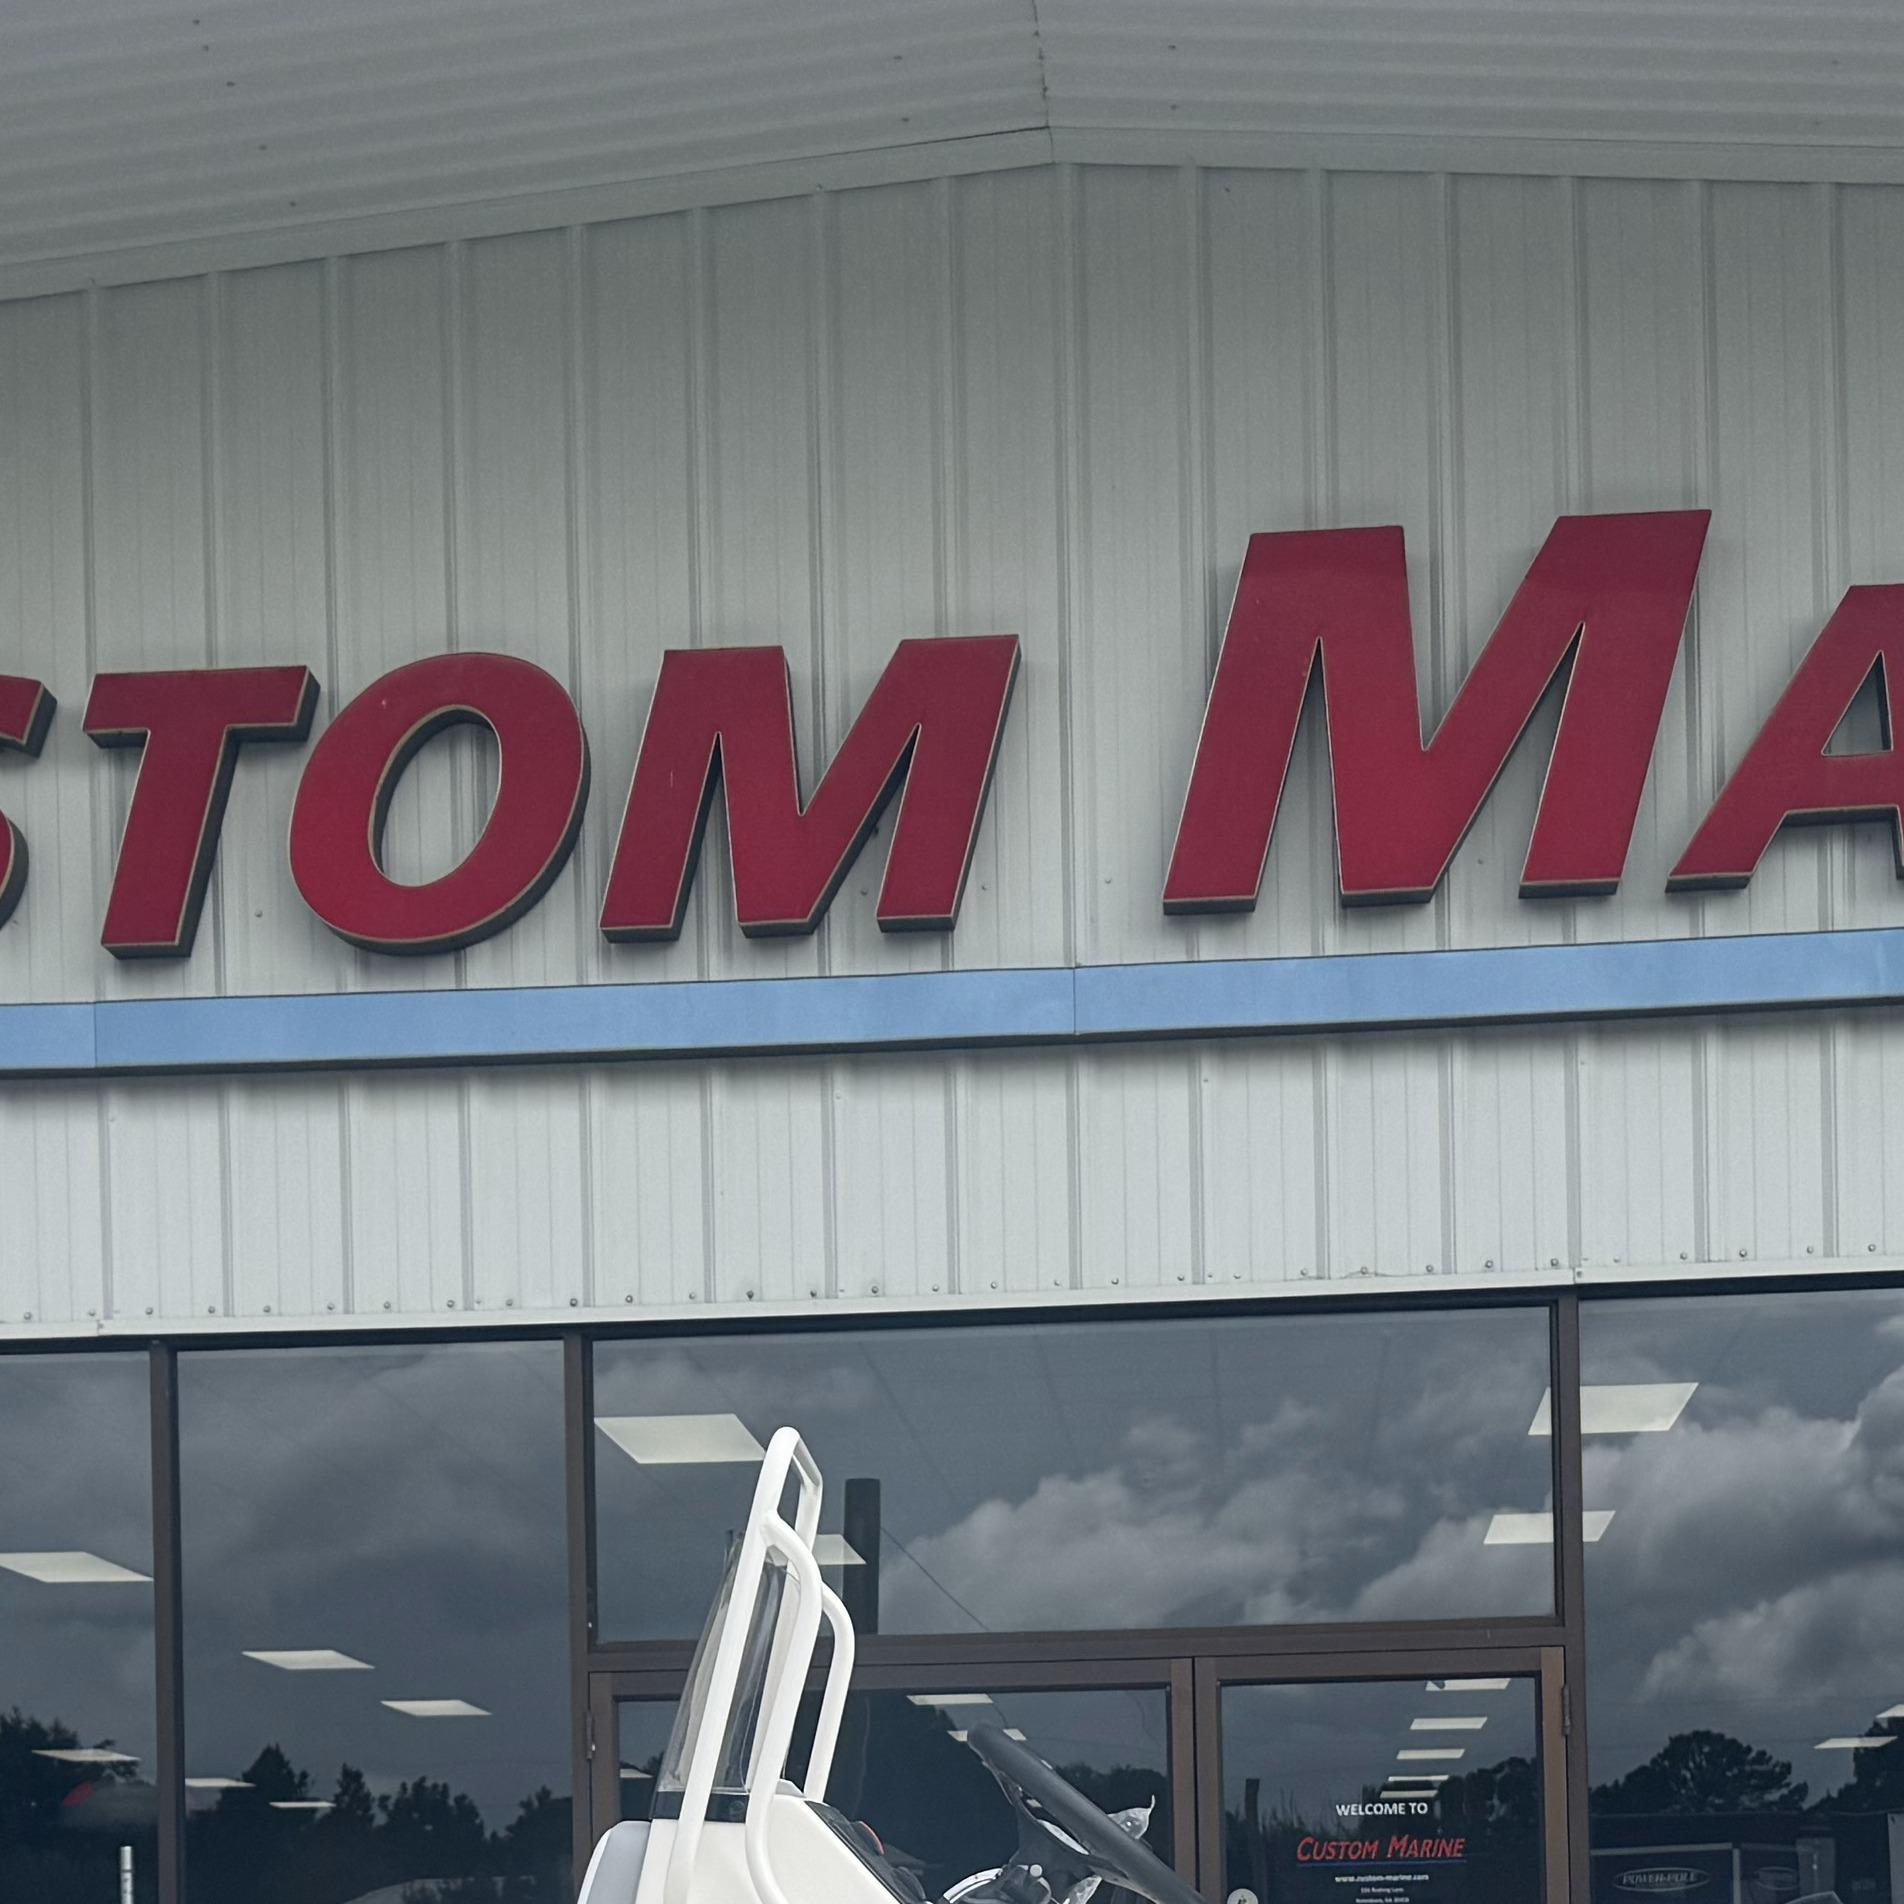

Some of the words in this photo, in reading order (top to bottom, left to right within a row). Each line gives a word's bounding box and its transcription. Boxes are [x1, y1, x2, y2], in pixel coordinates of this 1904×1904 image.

[1336, 1803, 1406, 1816] WELCOME
[1409, 1802, 1428, 1815] TO
[1297, 1836, 1380, 1861] CUSTOM
[1387, 1834, 1466, 1858] MARINE
